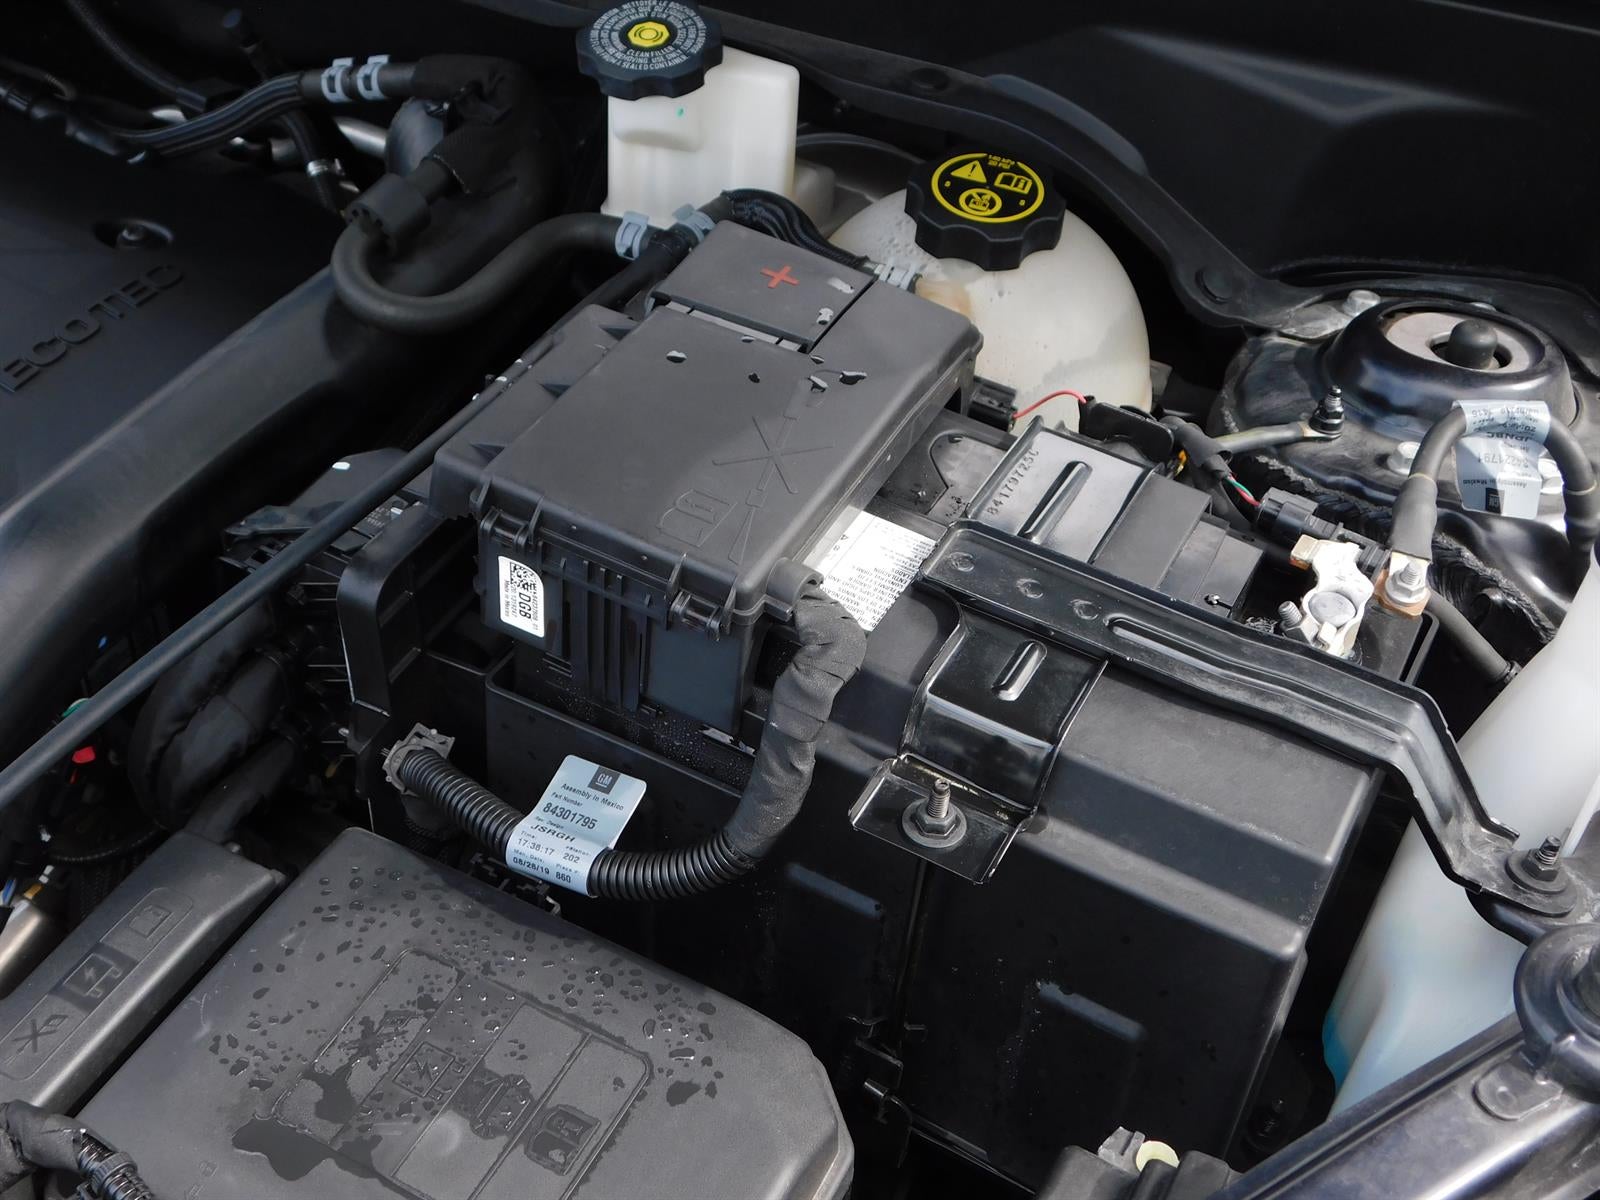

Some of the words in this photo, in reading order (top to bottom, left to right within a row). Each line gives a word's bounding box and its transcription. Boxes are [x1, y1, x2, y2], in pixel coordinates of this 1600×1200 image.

[0, 264, 185, 392] ECOTEC
[518, 592, 532, 619] DGB
[596, 772, 613, 786] GM
[560, 783, 591, 800] Assembly
[592, 793, 600, 802] in
[600, 797, 624, 811] Mexico
[542, 802, 598, 830] 84301795
[530, 824, 576, 842] JSRGH
[563, 852, 580, 864] 202
